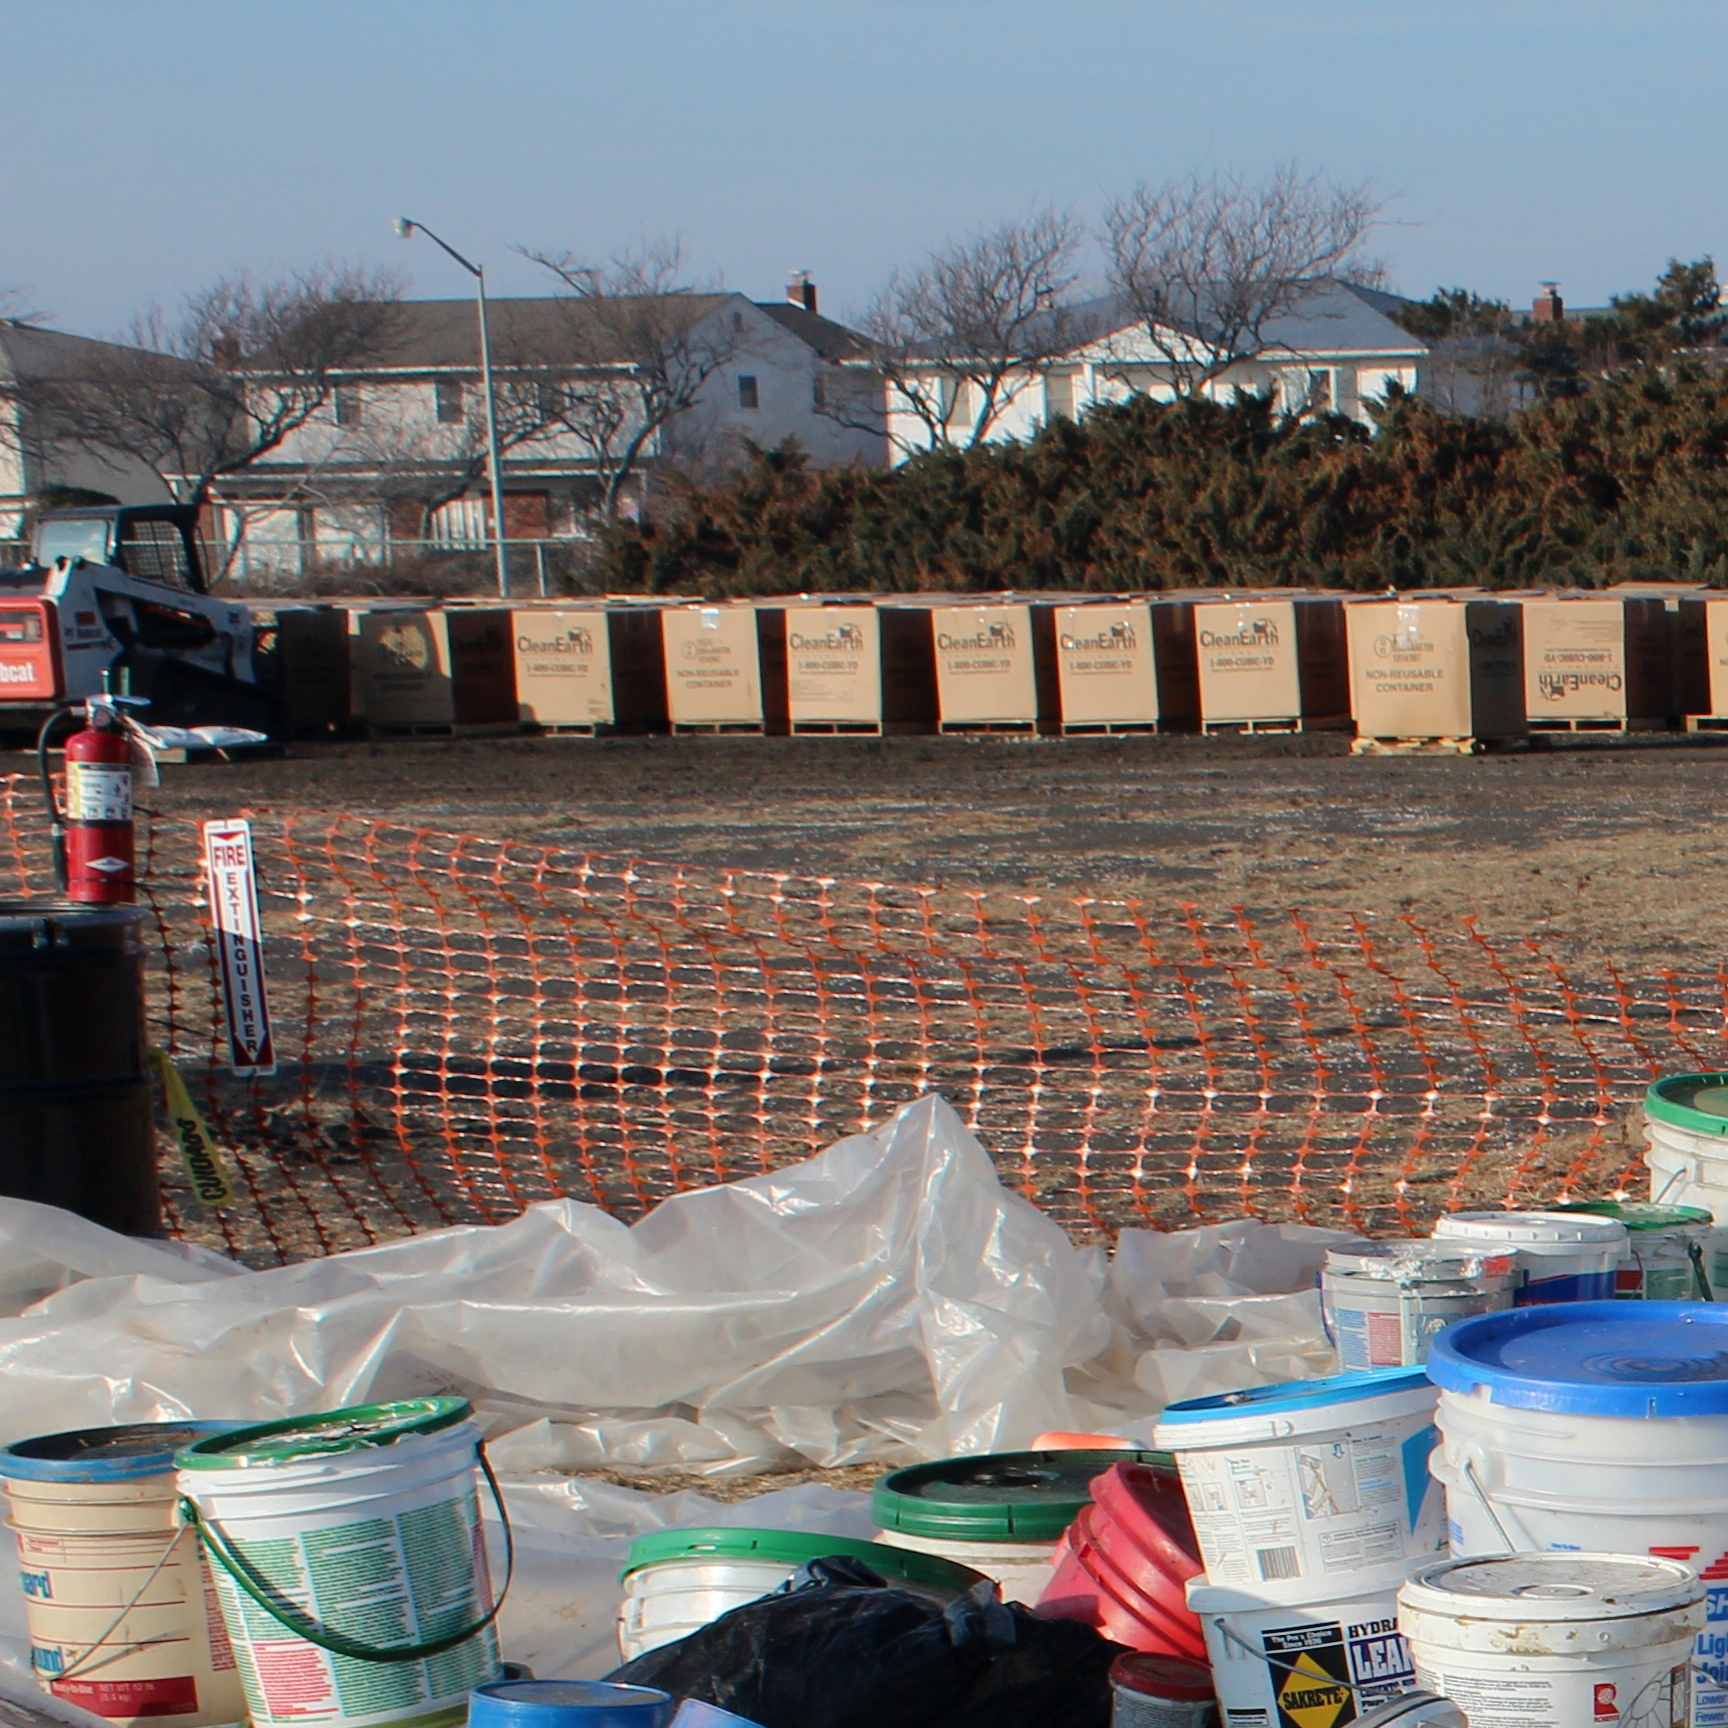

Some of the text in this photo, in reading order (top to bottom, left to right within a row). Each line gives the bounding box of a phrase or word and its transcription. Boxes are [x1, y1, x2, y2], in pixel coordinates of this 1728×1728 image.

[1366, 669, 1444, 680] NON-REUSABLE
[1376, 682, 1434, 692] CONTAINER
[213, 845, 246, 867] FIRE
[226, 873, 259, 1053] EXTINGUISHER
[1308, 1629, 1332, 1640] Choice
[1282, 1686, 1341, 1711] SAKRETE
[1695, 1709, 1725, 1722] Fewer
